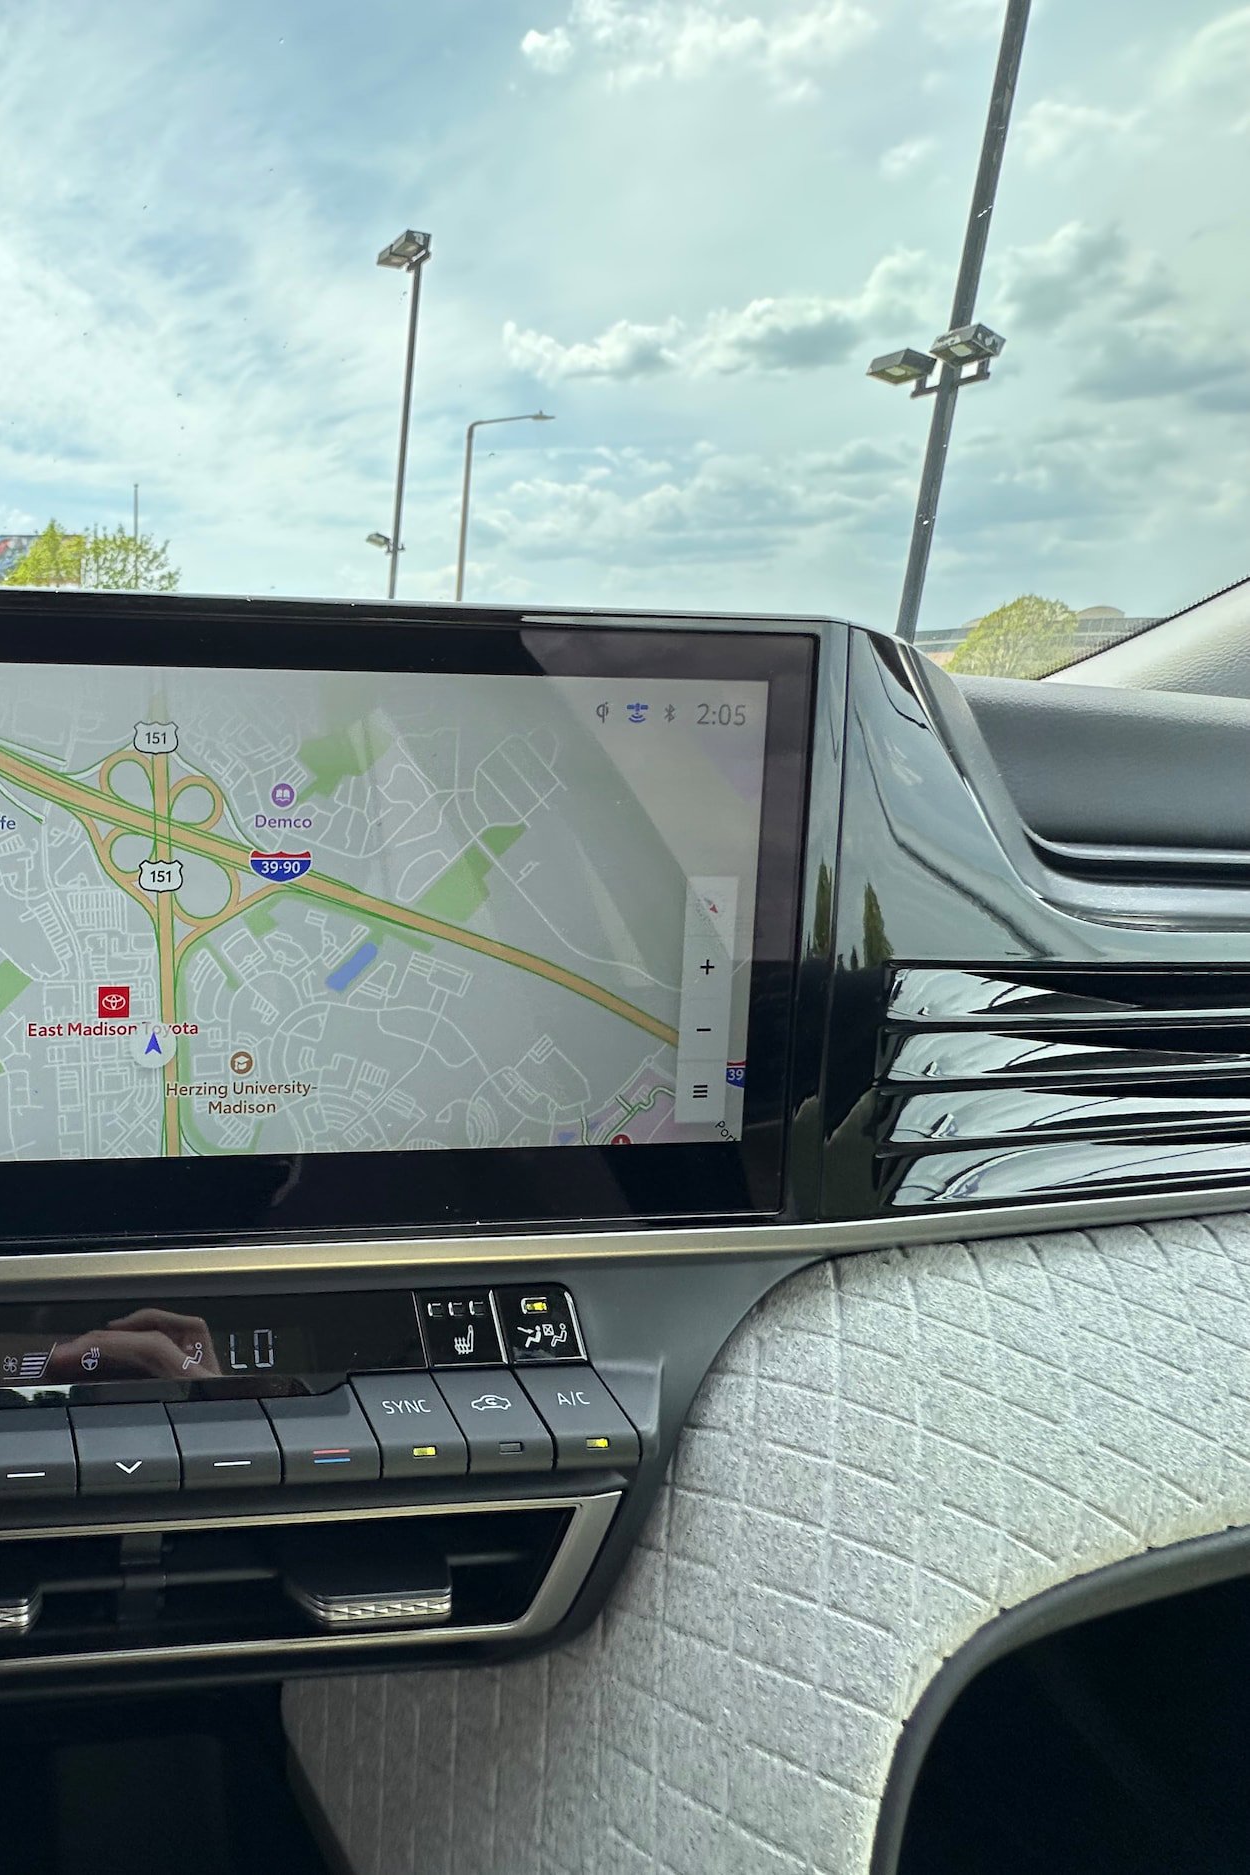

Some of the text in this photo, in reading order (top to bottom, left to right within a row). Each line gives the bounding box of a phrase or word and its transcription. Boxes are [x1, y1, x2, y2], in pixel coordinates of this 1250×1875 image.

[697, 703, 746, 726] 2:05
[145, 731, 168, 747] 151
[254, 814, 313, 830] Demco
[150, 869, 173, 885] 151
[27, 1023, 63, 1037] East
[68, 1022, 137, 1037] Madison
[166, 1081, 318, 1101] Herzing University-
[208, 1100, 277, 1115] Madison
[556, 1390, 591, 1407] A/C
[381, 1398, 432, 1416] SYNC
